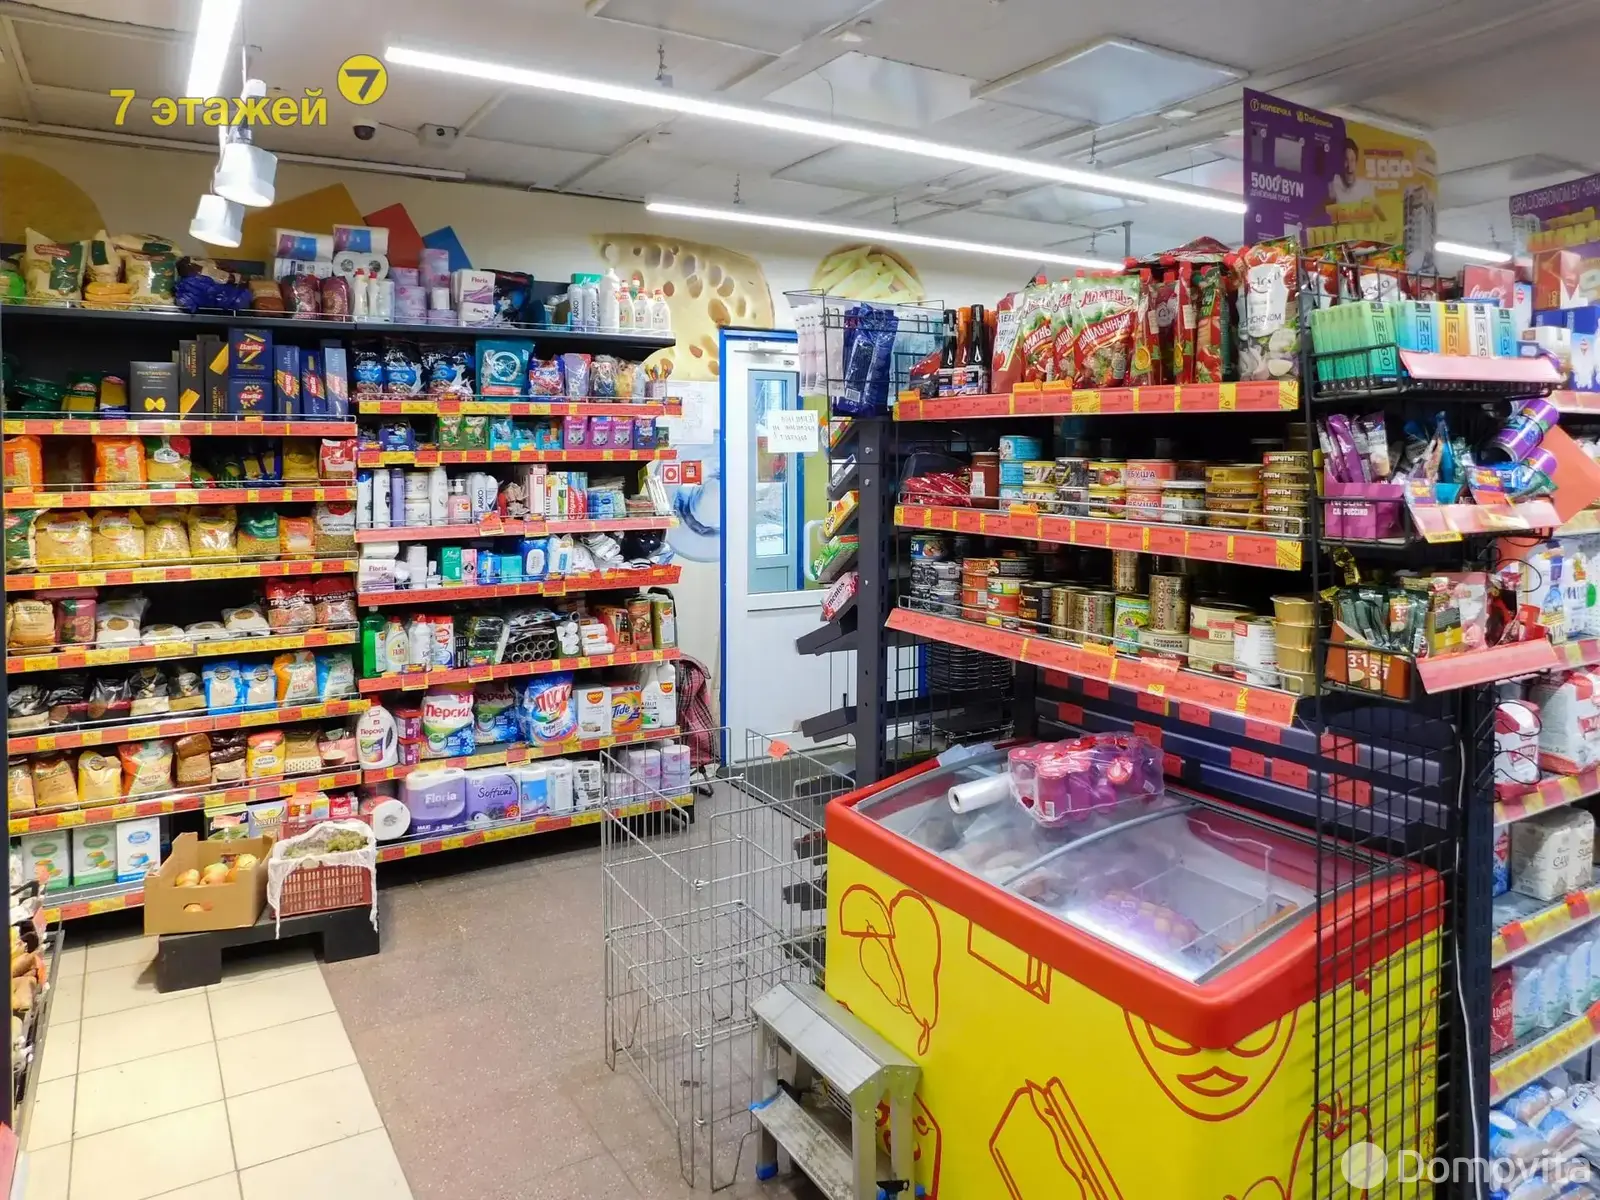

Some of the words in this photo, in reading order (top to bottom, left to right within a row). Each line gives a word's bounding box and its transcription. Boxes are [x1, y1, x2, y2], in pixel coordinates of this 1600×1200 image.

[1282, 179, 1304, 198] BYN
[425, 704, 470, 720] Персил
[612, 704, 630, 718] Tide
[360, 728, 385, 736] Персил
[425, 792, 457, 804] Floria
